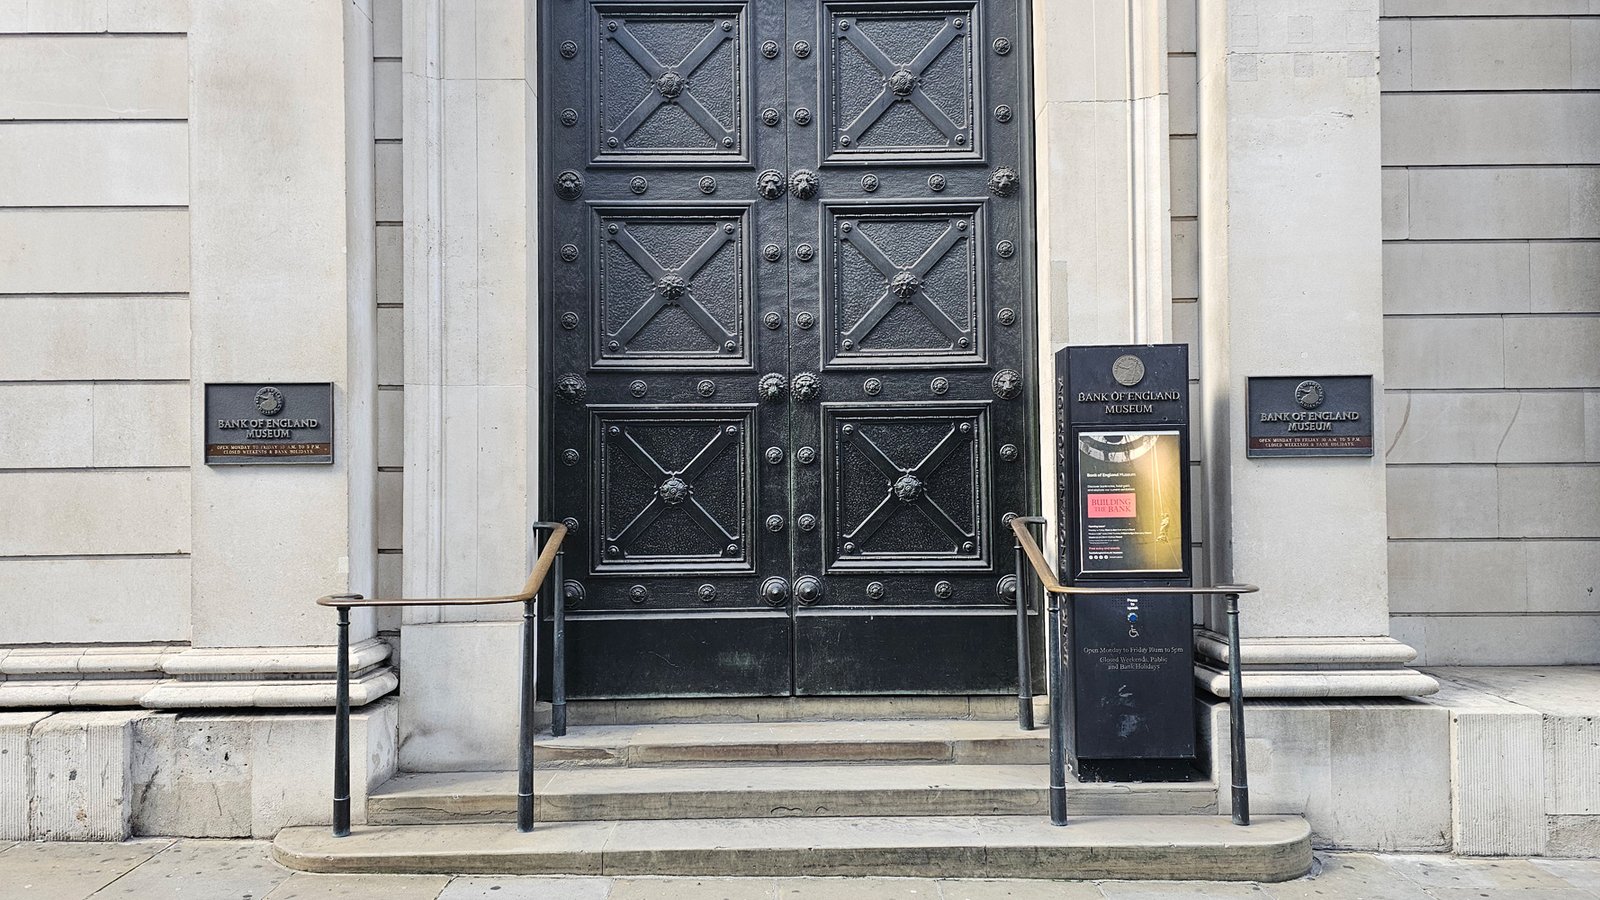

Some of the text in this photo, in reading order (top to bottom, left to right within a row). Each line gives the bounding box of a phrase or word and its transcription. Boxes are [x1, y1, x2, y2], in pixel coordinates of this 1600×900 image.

[1078, 391, 1180, 402] BANK OF ENGLAND
[1105, 404, 1153, 414] MUSEUM
[1260, 411, 1359, 422] BANK OF ENGLAND
[218, 419, 318, 429] BANK OF ENGLAND
[1288, 422, 1332, 431] MUSEUM
[246, 429, 290, 439] MUSEUM
